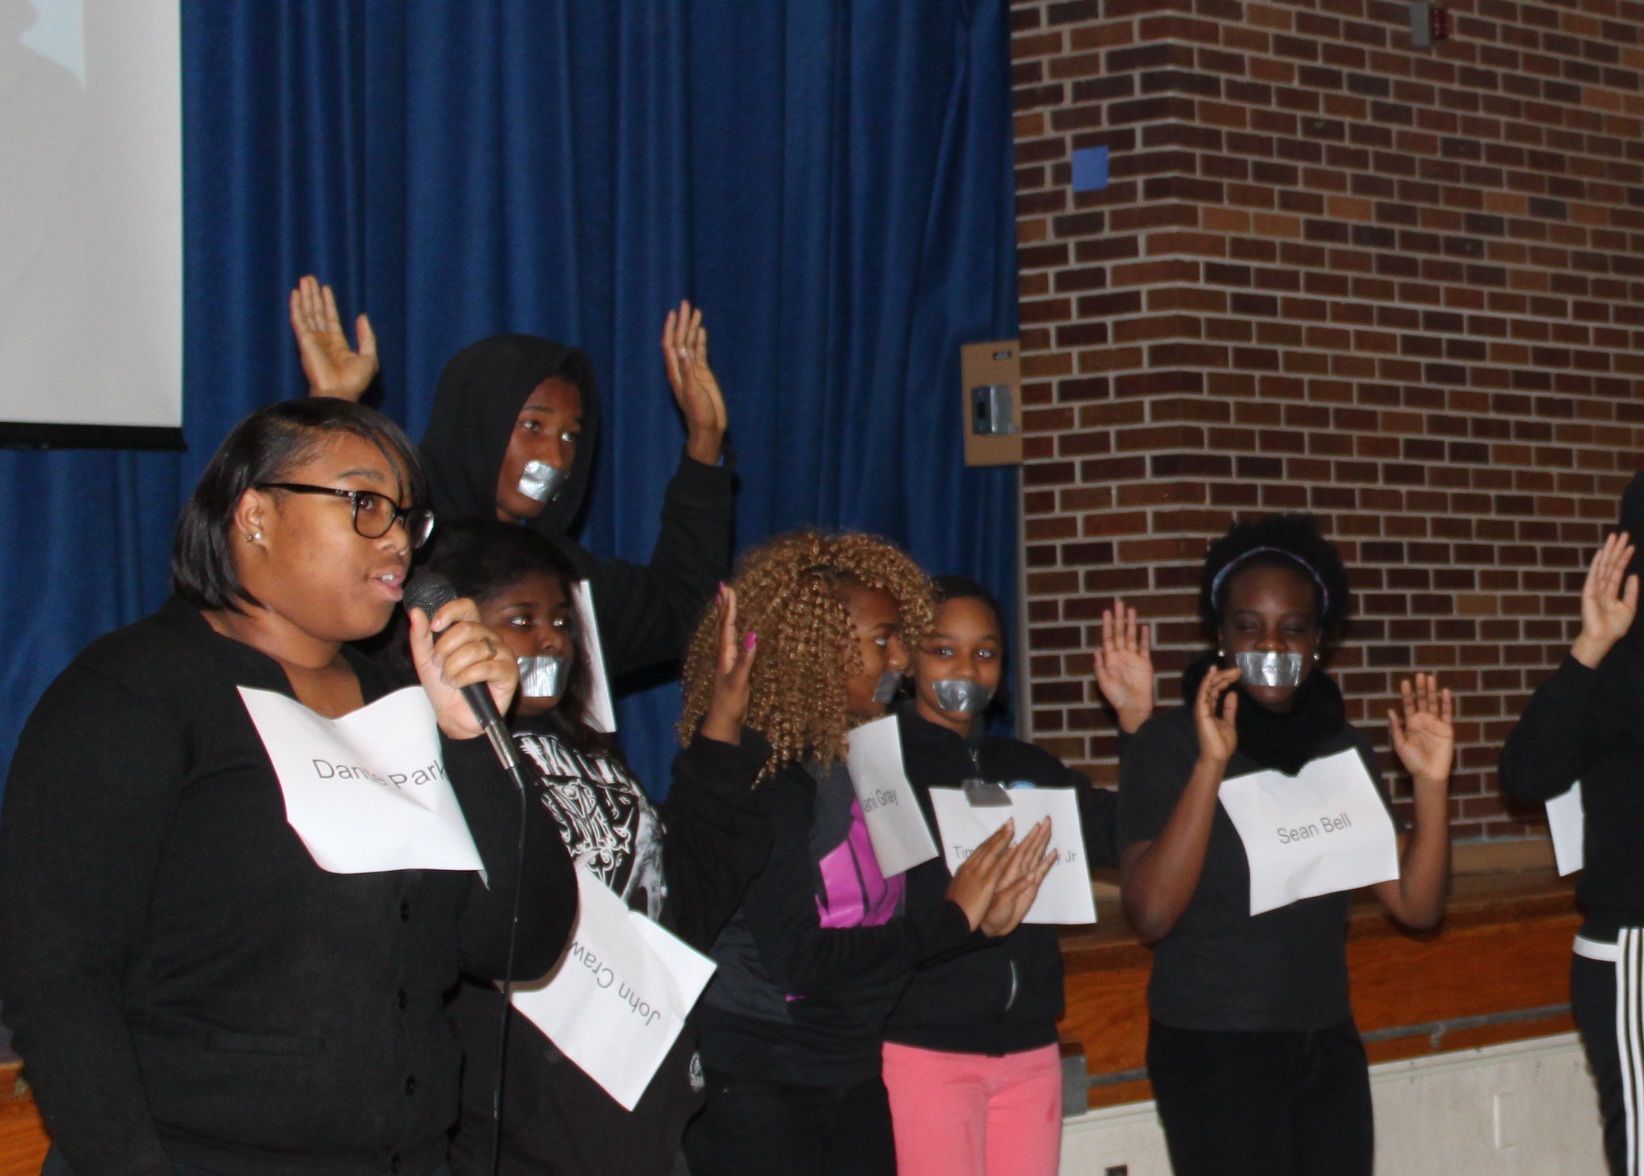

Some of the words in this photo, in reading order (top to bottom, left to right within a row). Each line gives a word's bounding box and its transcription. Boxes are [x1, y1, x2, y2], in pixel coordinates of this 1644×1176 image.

[312, 758, 388, 786] Dane
[388, 759, 447, 789] Park
[1276, 824, 1320, 844] Sean
[1319, 812, 1352, 833] Bell
[570, 941, 615, 988] Craw
[617, 982, 661, 1026] John
